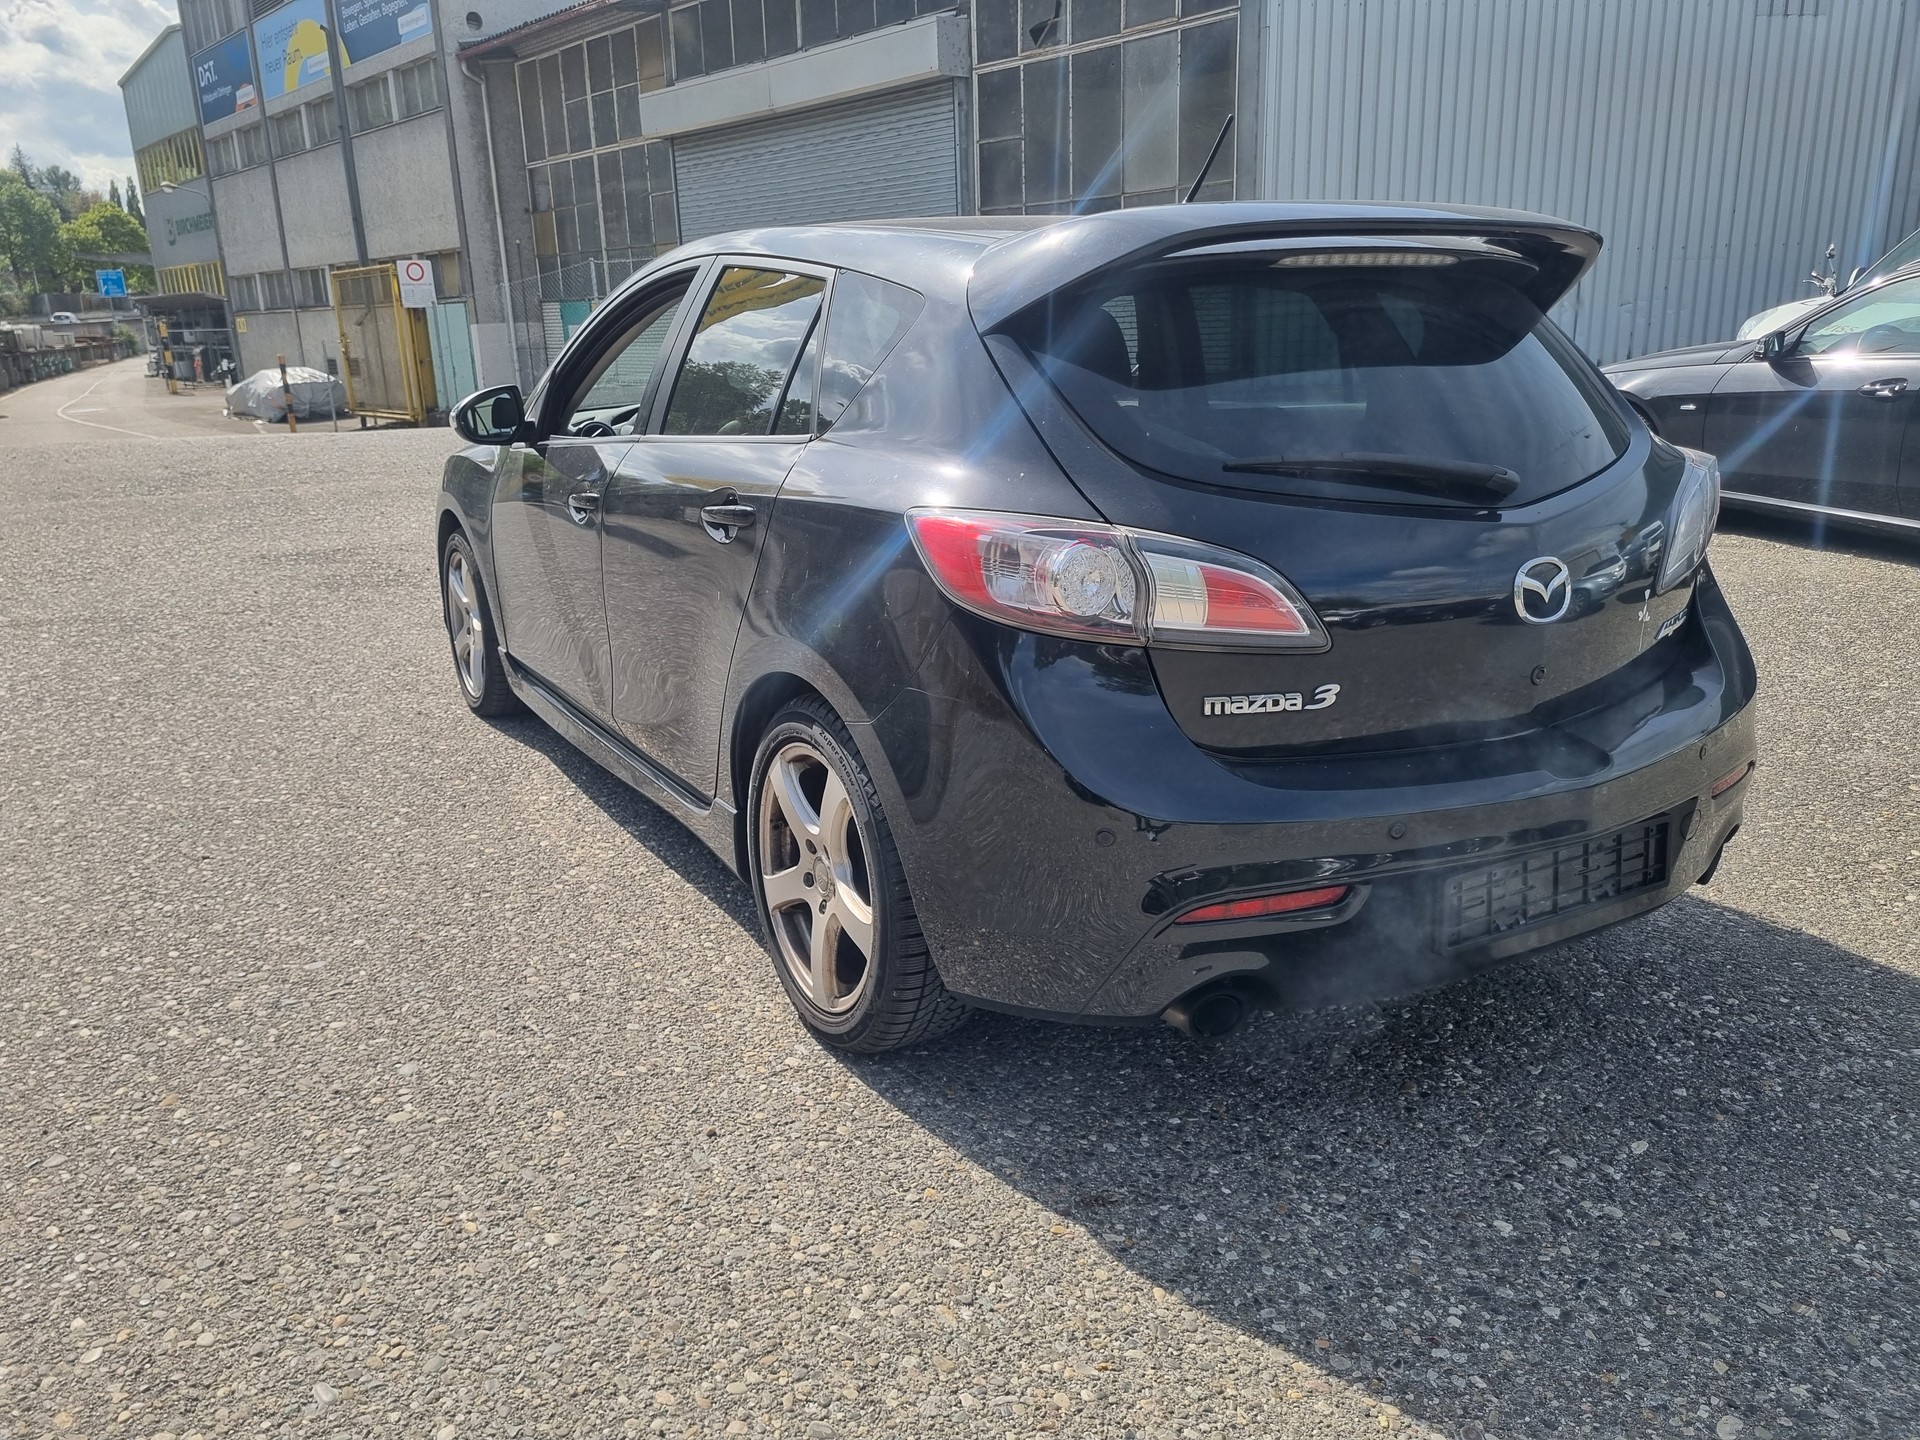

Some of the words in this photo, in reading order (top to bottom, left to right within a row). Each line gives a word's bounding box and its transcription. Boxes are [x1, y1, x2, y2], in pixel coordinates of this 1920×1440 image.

[1304, 684, 1341, 710] 3
[819, 729, 840, 756] Zuper
[838, 756, 855, 787] Snow
